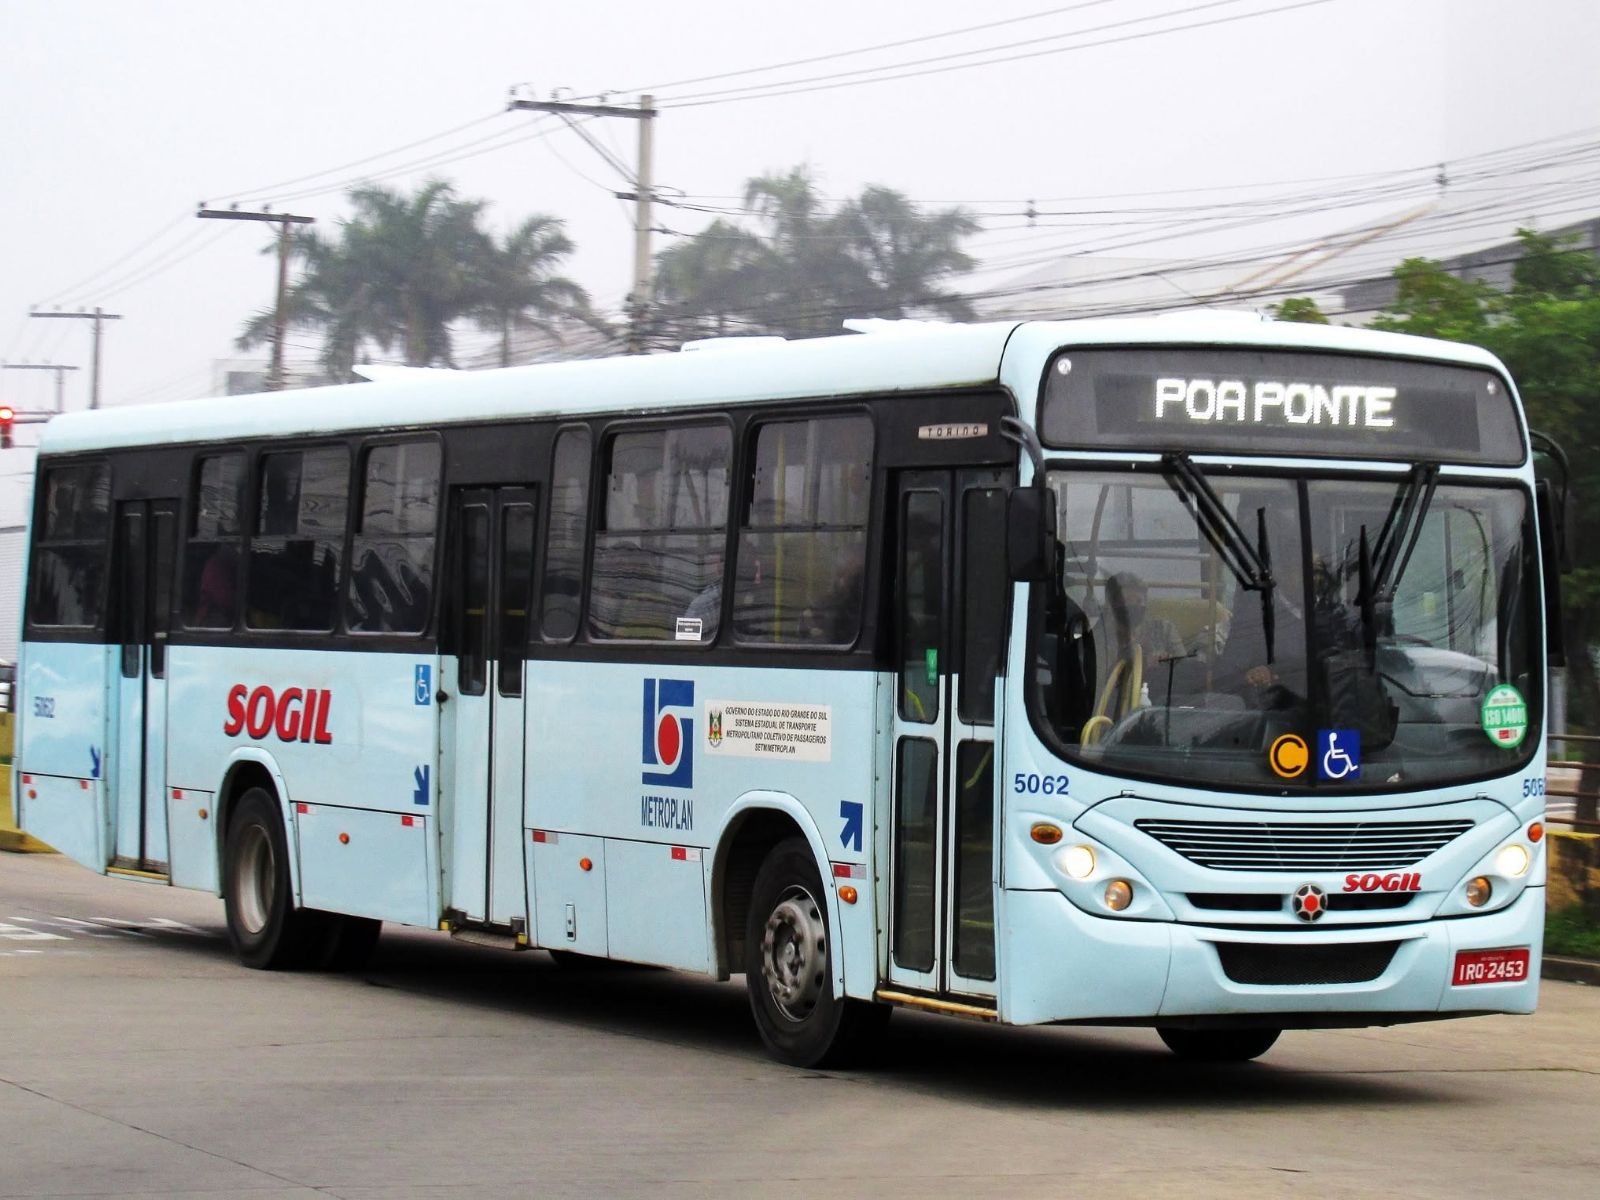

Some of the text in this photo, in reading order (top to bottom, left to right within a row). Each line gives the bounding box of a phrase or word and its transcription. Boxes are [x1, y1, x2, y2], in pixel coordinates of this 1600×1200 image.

[1155, 378, 1397, 427] POA PONTE
[927, 426, 979, 439] TORINO
[223, 683, 333, 744] SOGIL
[725, 706, 828, 720] GOVERNO DO ESTADO DO RIO GRANDE DO SUL
[735, 718, 817, 731] SISTEMA ESTADUAL DE TRANSPORTE
[726, 729, 827, 744] METROPOLITANO COLETIVO DE PASSAGEIROS
[1014, 773, 1070, 795] 5062
[641, 795, 693, 831] METROPLAN
[1342, 872, 1422, 892] SOGIL
